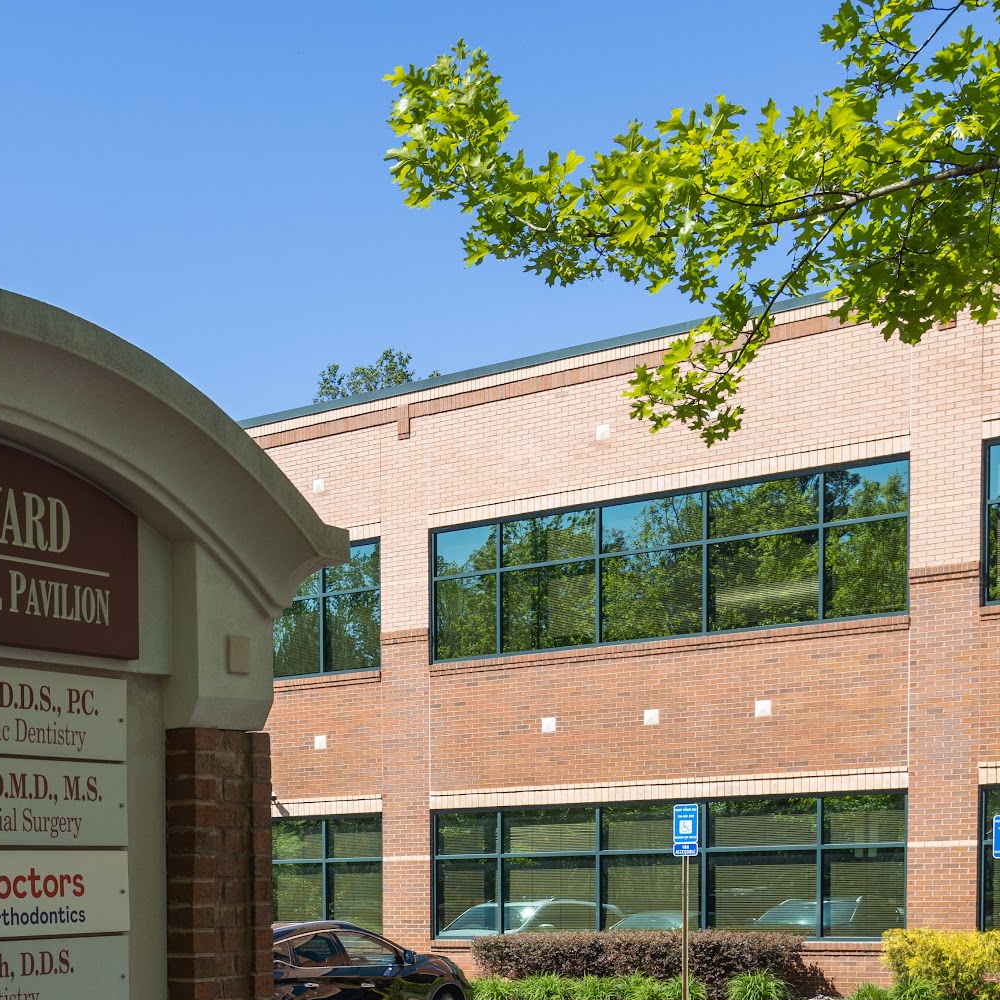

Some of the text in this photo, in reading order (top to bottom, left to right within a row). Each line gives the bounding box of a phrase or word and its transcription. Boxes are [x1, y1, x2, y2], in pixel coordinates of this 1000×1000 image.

[9, 570, 110, 625] PAVILION
[15, 719, 86, 752] Dentistry
[63, 776, 102, 801] M.S.
[23, 808, 82, 838] Surgery
[20, 950, 74, 976] D.D.S.
